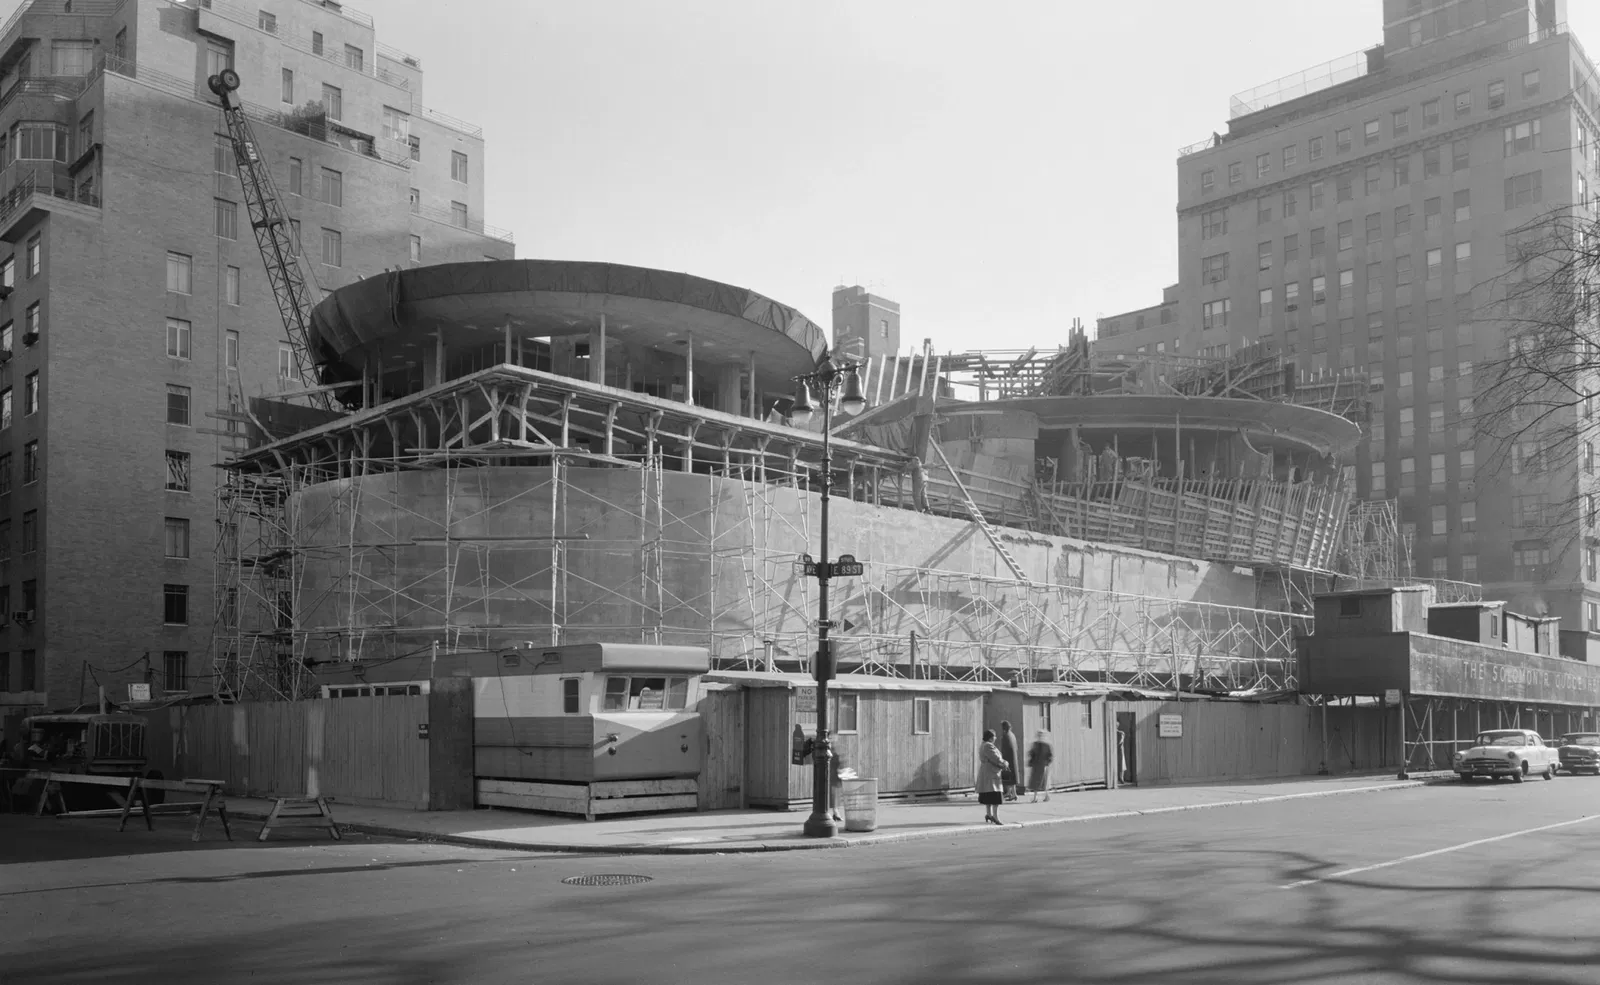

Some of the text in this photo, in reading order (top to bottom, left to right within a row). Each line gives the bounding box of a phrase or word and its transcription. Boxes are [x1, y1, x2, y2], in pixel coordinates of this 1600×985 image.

[806, 564, 817, 574] AVE
[833, 564, 862, 575] E 89 ST
[1463, 661, 1485, 680] THE
[1492, 665, 1538, 685] SOLOMON
